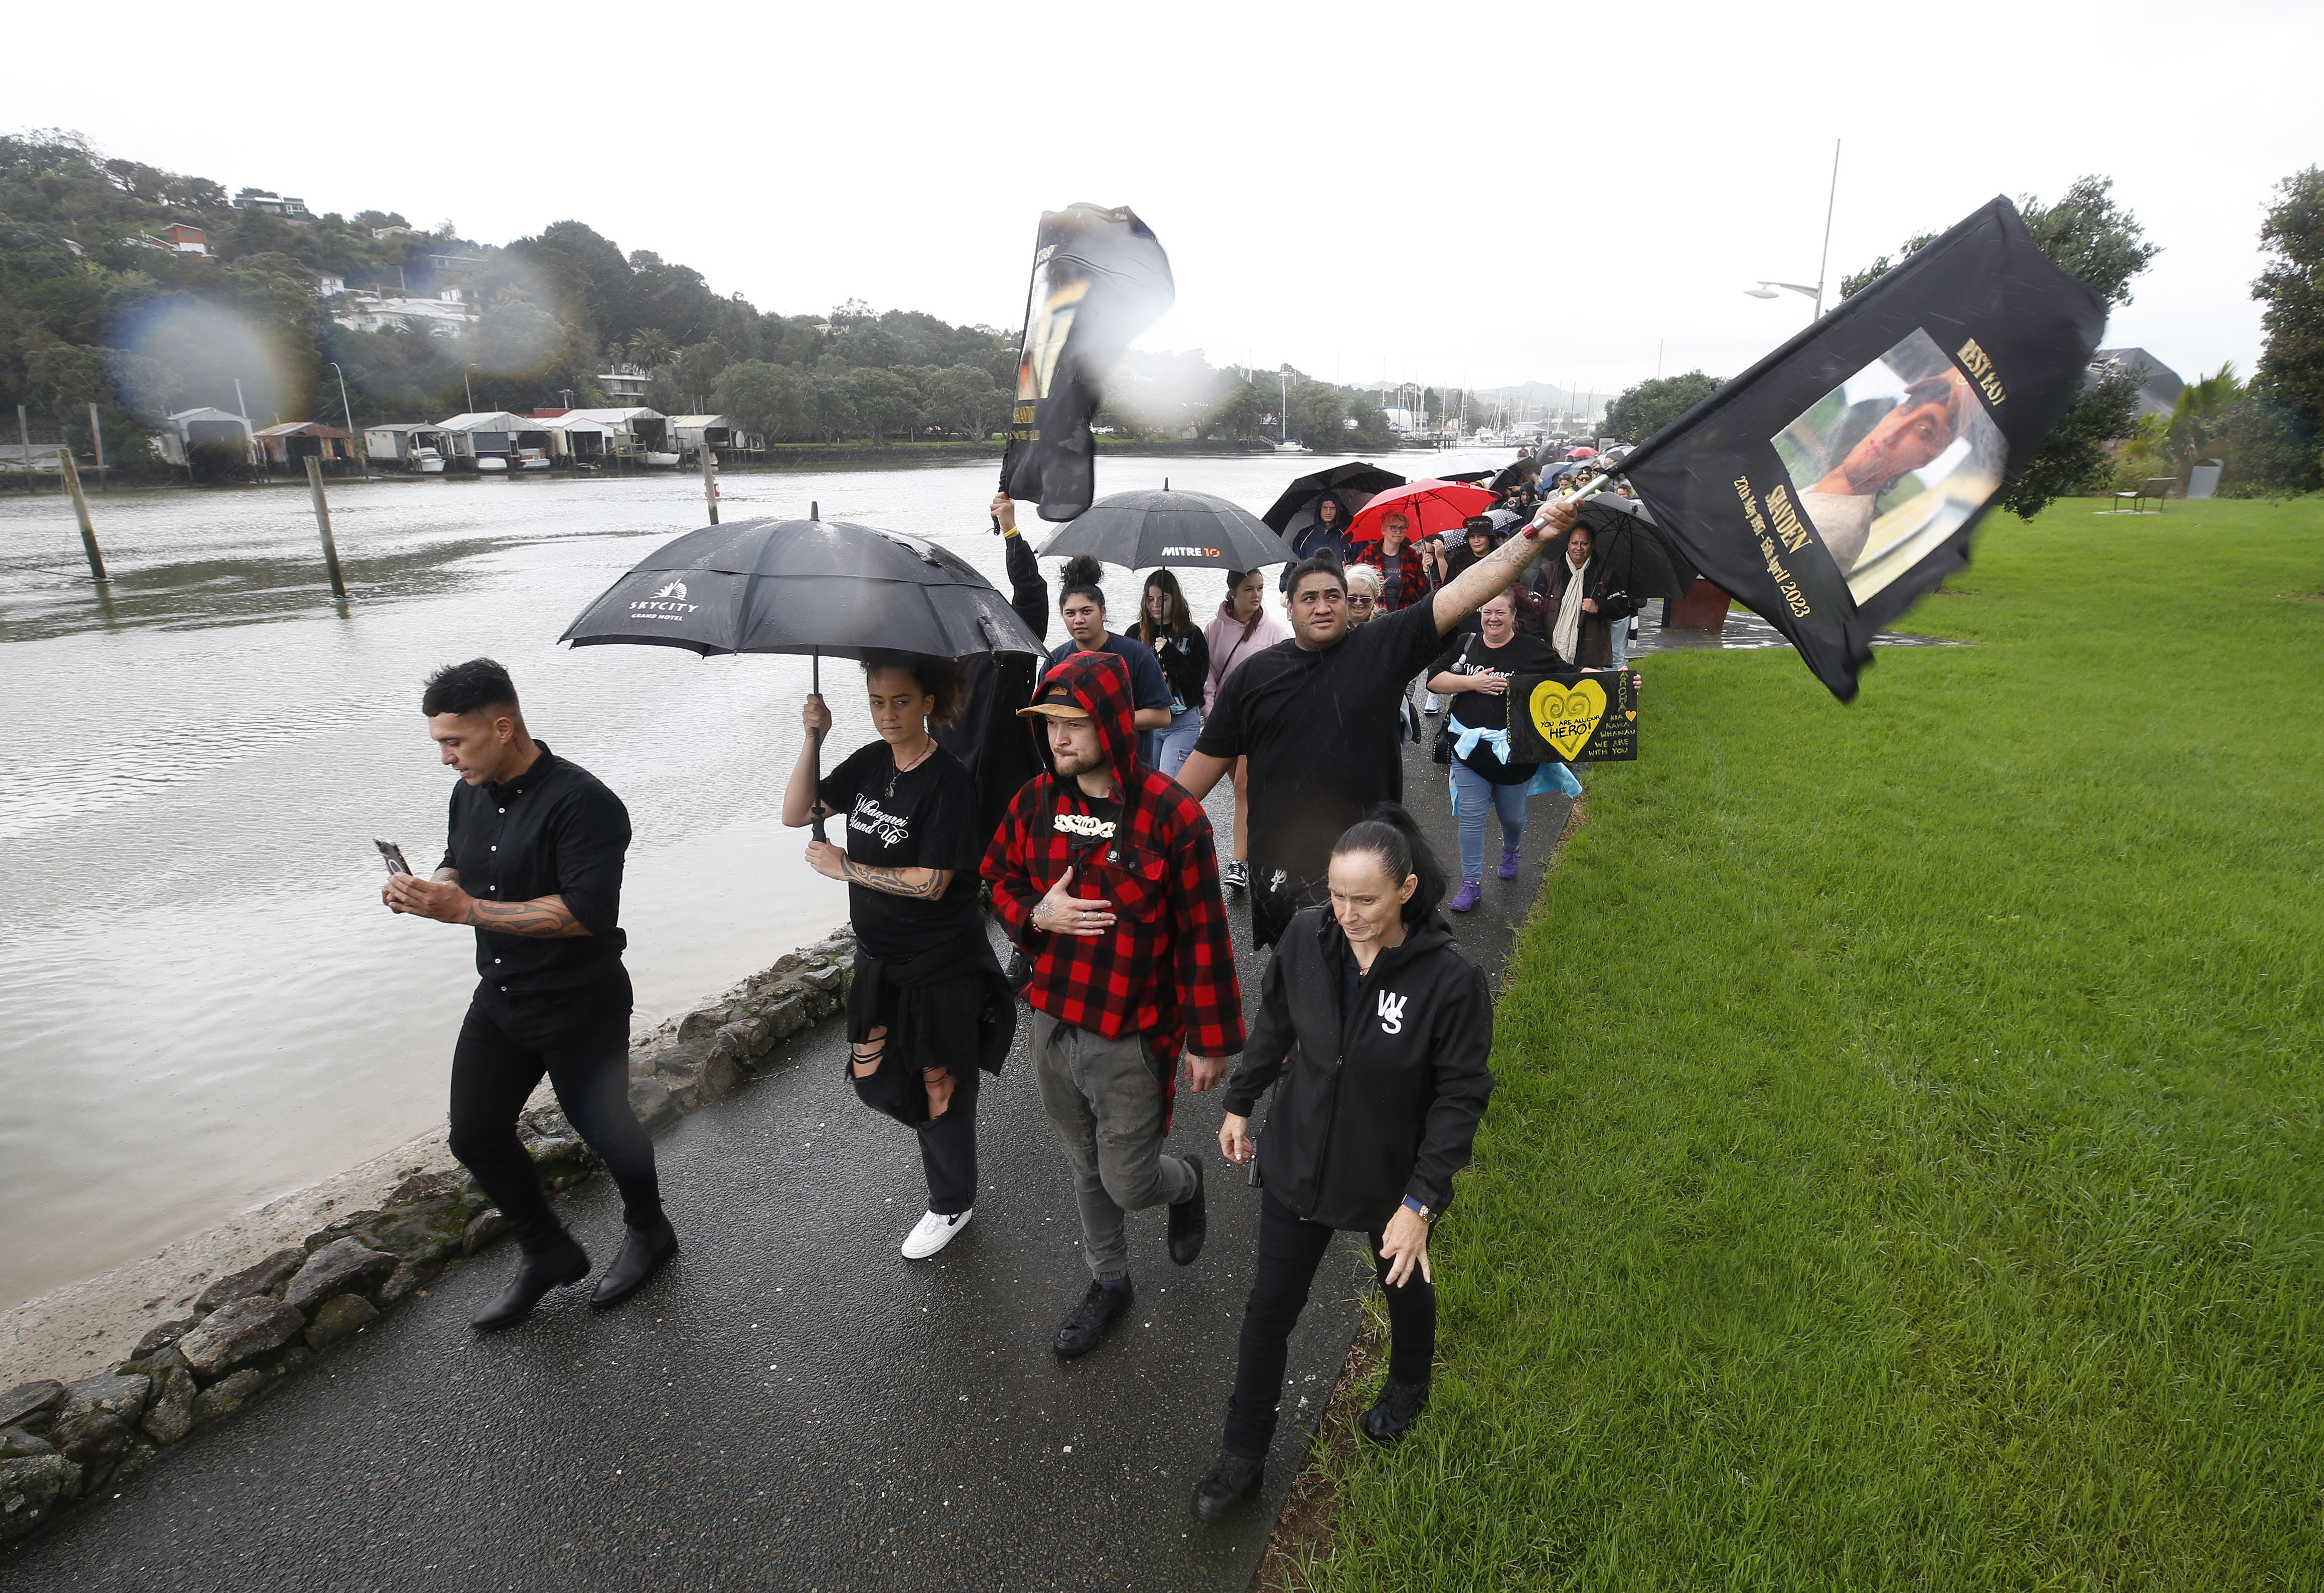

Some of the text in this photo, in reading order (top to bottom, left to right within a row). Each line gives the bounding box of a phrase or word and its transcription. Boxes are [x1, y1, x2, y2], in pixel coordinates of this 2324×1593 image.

[1956, 337, 2007, 406] REST EASY
[1765, 484, 1813, 554] SHAYDEN
[1161, 547, 1221, 558] MITRE 10
[1733, 475, 1751, 501] 27th
[1743, 495, 1757, 519] May
[1767, 555, 1791, 583] April
[1780, 581, 1810, 618] 2023
[629, 601, 699, 613] SKYCITY
[1617, 671, 1629, 712] AROHA
[1550, 721, 1591, 739] HERO!
[1600, 729, 1636, 738] WHANAU
[1612, 739, 1629, 747] ARE
[855, 793, 909, 827] Whangarei
[849, 809, 909, 848] Stand Up
